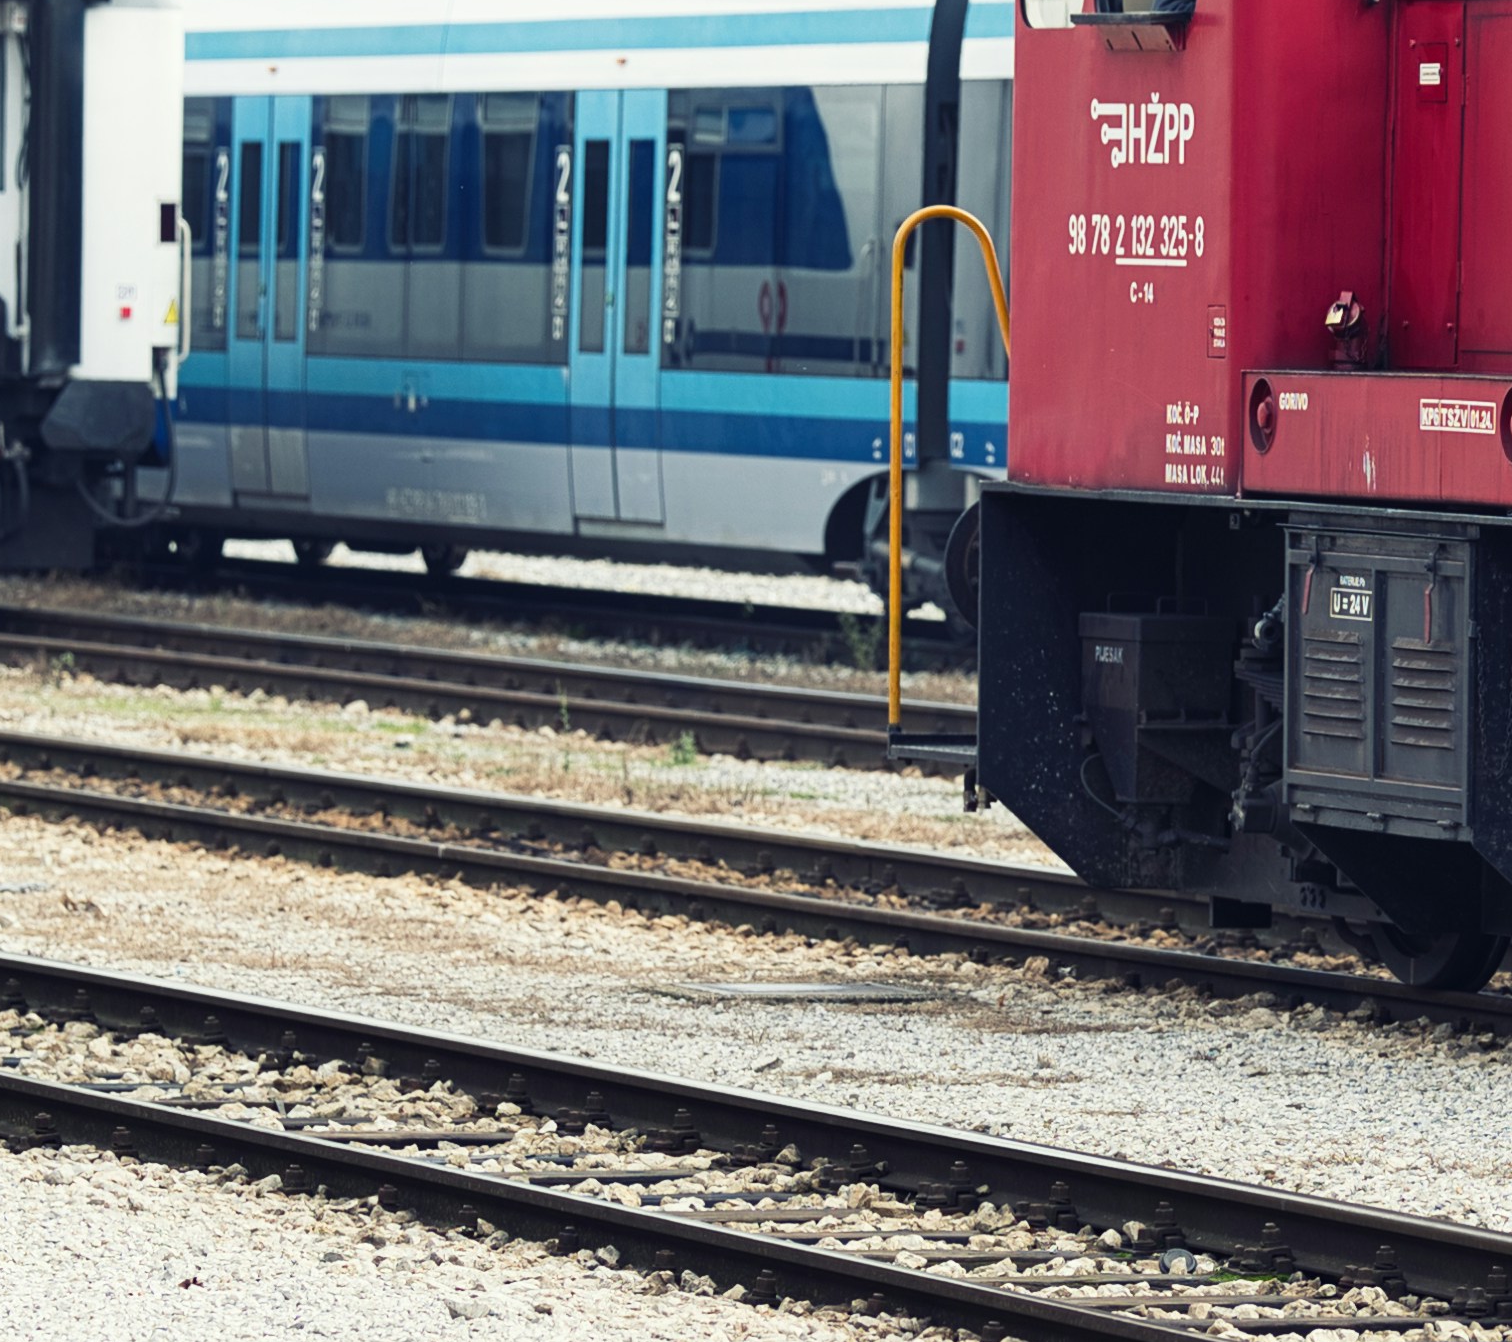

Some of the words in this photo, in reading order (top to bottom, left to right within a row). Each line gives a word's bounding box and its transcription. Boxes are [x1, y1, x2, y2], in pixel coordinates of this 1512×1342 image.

[1128, 92, 1195, 164] HŽPP
[556, 151, 571, 203] 2
[667, 150, 682, 203] 2
[1068, 214, 1087, 255] 98
[1091, 214, 1110, 255] 78
[1115, 214, 1125, 256] 2
[1131, 215, 1155, 256] 132
[1160, 215, 1205, 258] 325-8
[1166, 401, 1184, 425] KOČ.
[1279, 392, 1309, 411] GORIVO
[1440, 405, 1468, 428] TSŽV
[1165, 430, 1183, 455] KOČ.
[1184, 435, 1206, 456] MASA
[1210, 436, 1225, 457] 30t
[1165, 463, 1188, 484] MASA
[1190, 465, 1209, 486] LOK.
[1334, 593, 1341, 613] U
[1095, 645, 1123, 664] PIJESAK
